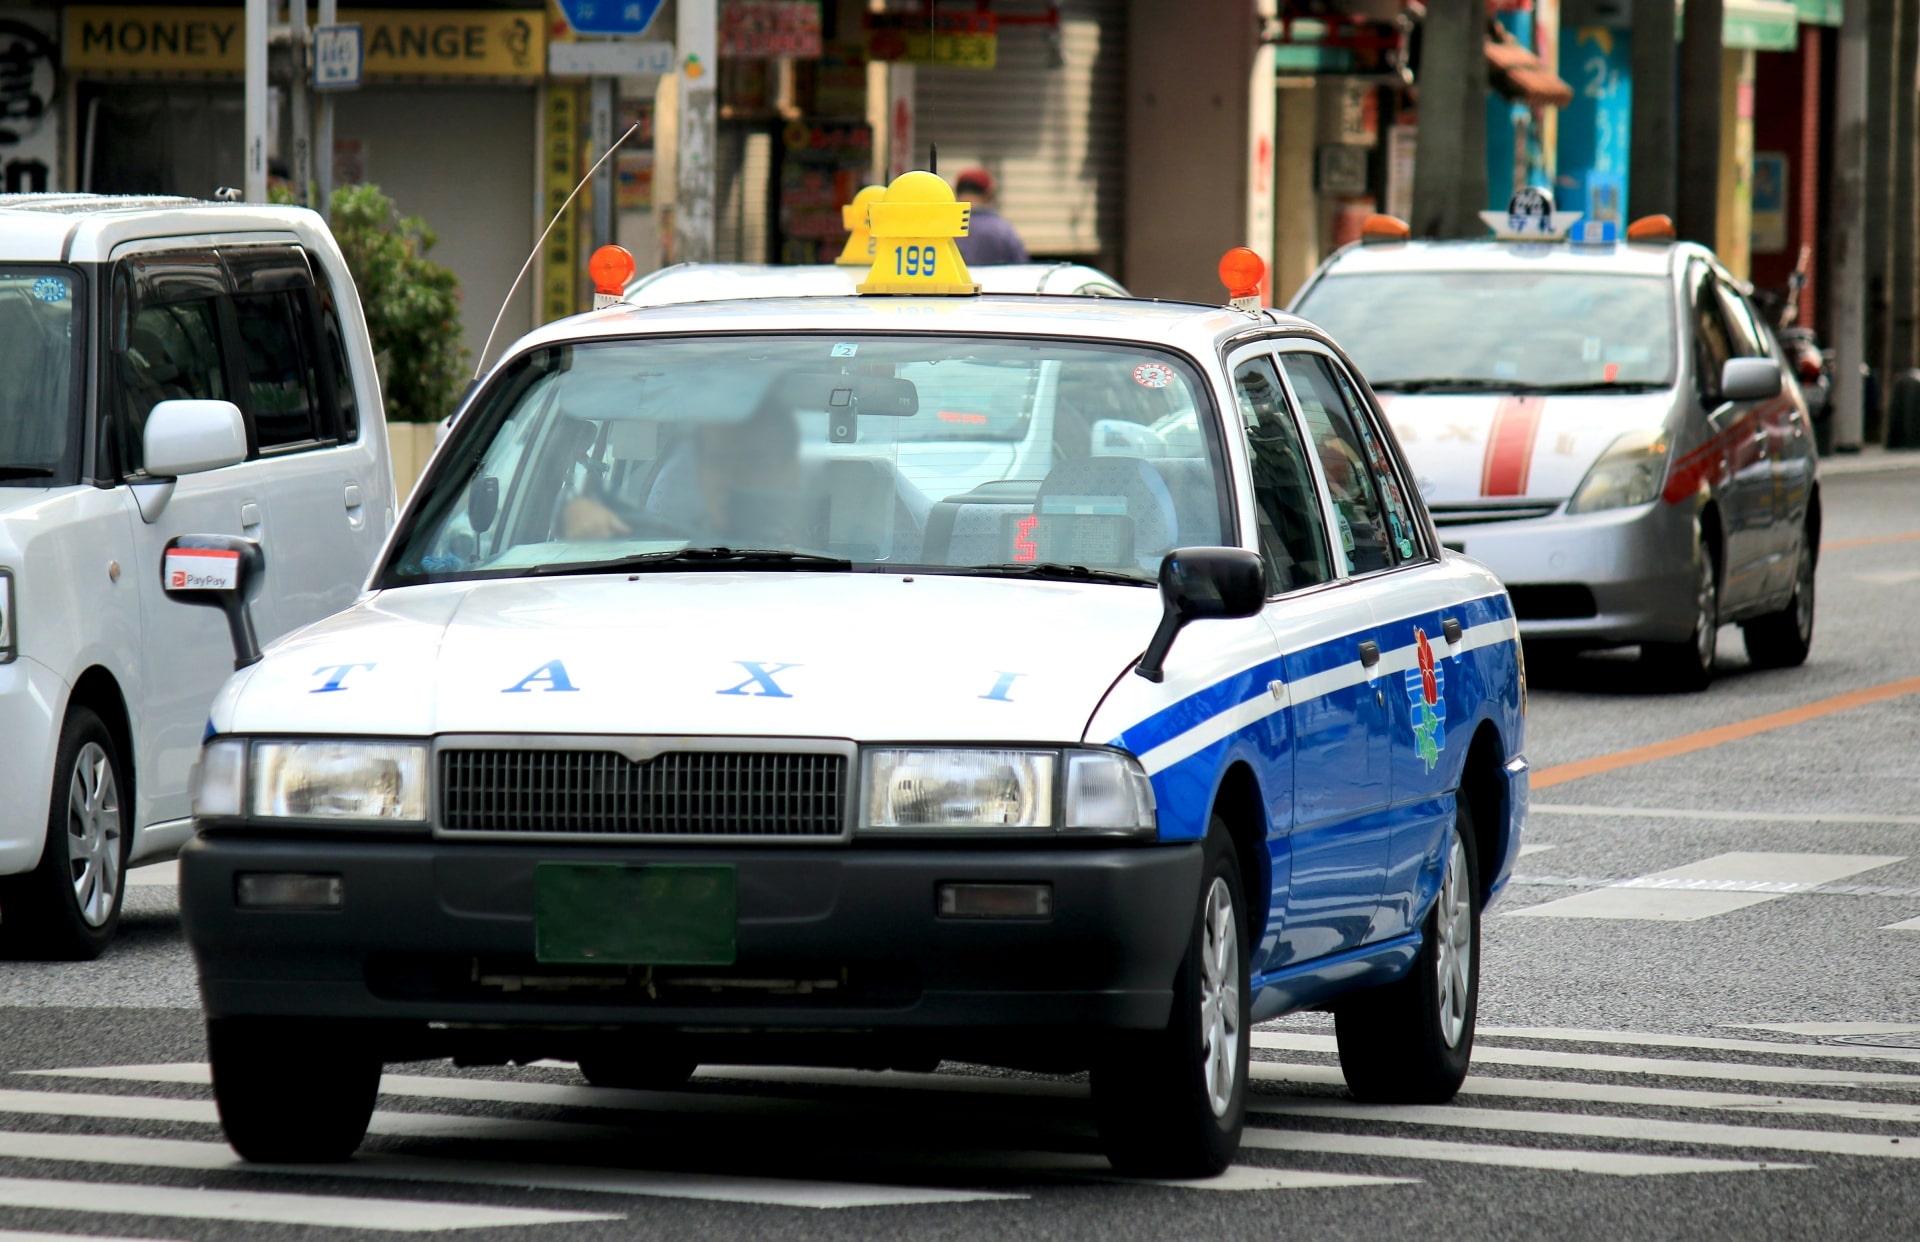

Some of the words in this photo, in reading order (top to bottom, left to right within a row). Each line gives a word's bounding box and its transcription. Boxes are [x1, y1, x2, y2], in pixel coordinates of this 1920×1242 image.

[82, 20, 236, 55] MONEY
[367, 24, 487, 59] ANGE
[895, 245, 936, 276] 199
[186, 574, 226, 587] PayPay
[308, 658, 1028, 702] TAXI
